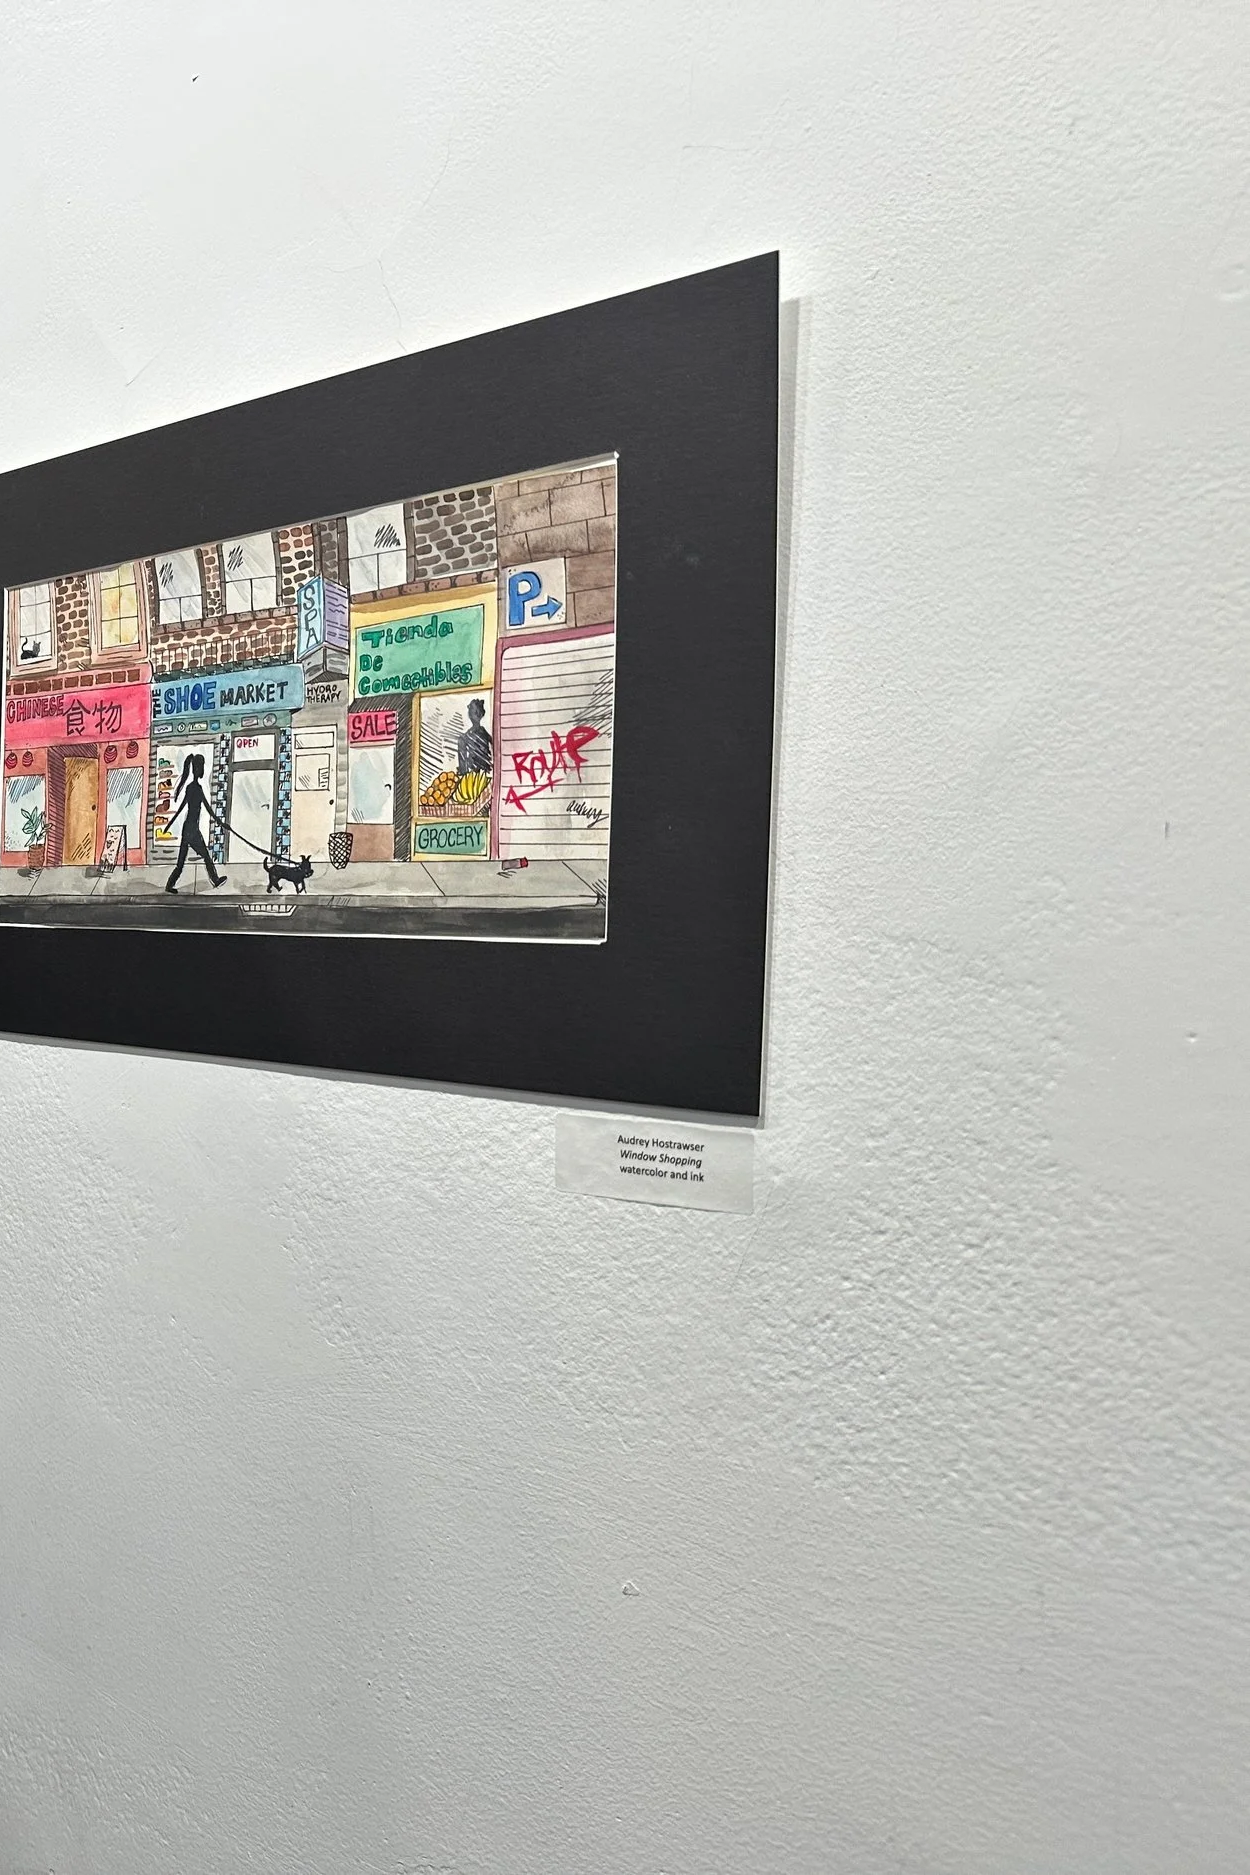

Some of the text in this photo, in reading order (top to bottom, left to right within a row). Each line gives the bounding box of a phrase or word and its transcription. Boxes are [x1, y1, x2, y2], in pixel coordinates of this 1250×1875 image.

[508, 571, 542, 627] P
[303, 584, 319, 649] SPA
[361, 615, 454, 648] Tienda
[152, 681, 289, 719] THE SHOE MARKET
[306, 684, 338, 696] HYDRO
[306, 690, 342, 704] THERAPY
[6, 694, 64, 724] CHINESE
[62, 698, 123, 736] 食物
[351, 712, 397, 740] SALE
[236, 738, 259, 749] OPEN
[418, 825, 483, 849] GROCERY
[617, 1134, 705, 1152] Audrey Hostrawser
[620, 1149, 703, 1169] Window Shopping
[619, 1165, 705, 1182] watercolor and ink
